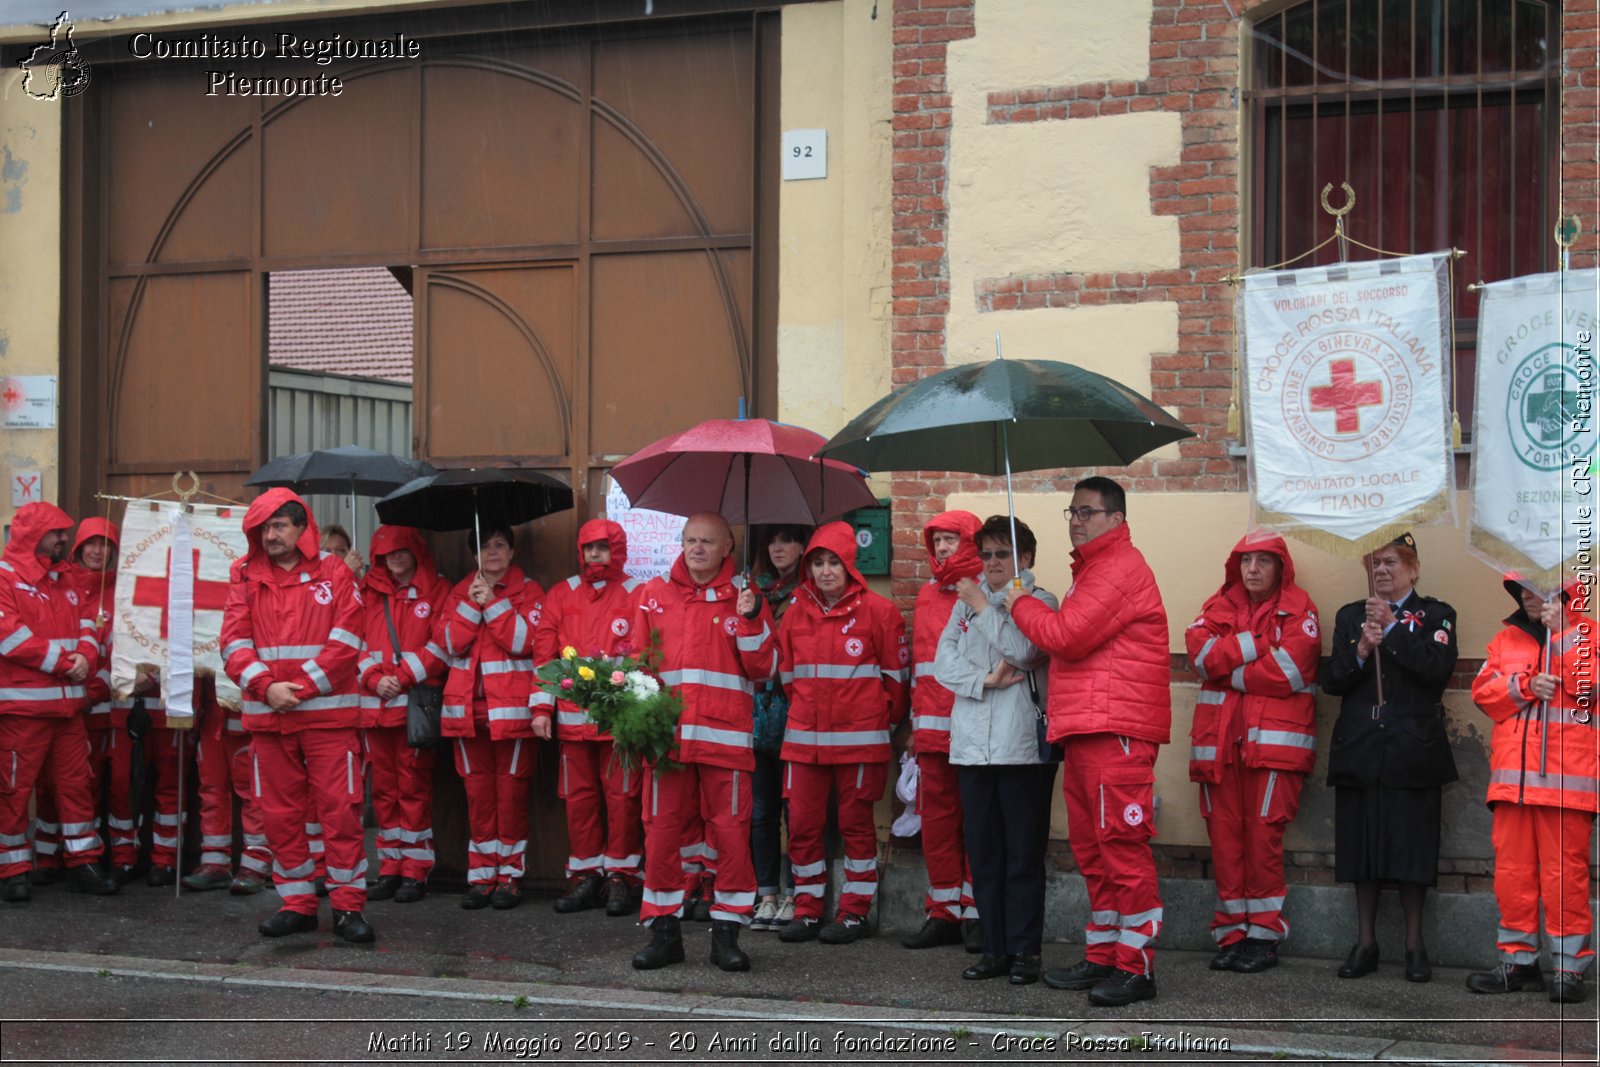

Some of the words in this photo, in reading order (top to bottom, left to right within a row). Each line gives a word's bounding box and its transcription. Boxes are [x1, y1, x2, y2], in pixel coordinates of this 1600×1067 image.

[1274, 293, 1327, 312] VOLONTARI
[1332, 292, 1350, 305] DEL
[1357, 285, 1408, 300] SOCCORSO
[1257, 332, 1299, 393] CROCE
[1296, 307, 1361, 337] ROSSA
[1367, 308, 1436, 378] ITALIANA
[1496, 310, 1554, 365] CROCE
[1301, 351, 1316, 366] DI
[1383, 353, 1400, 370] 22
[1511, 352, 1551, 401] CROCE
[1286, 370, 1336, 455] CONVENZIONE
[1389, 374, 1409, 425] AGOSTO
[1524, 443, 1582, 466] TORINO
[1284, 475, 1356, 492] COMITATO
[1361, 469, 1420, 488] LOCALE
[1320, 492, 1384, 511] FIANO
[1516, 490, 1572, 503] SEZIONE
[121, 525, 173, 570] VOLONTARI
[122, 612, 150, 648] LANZO
